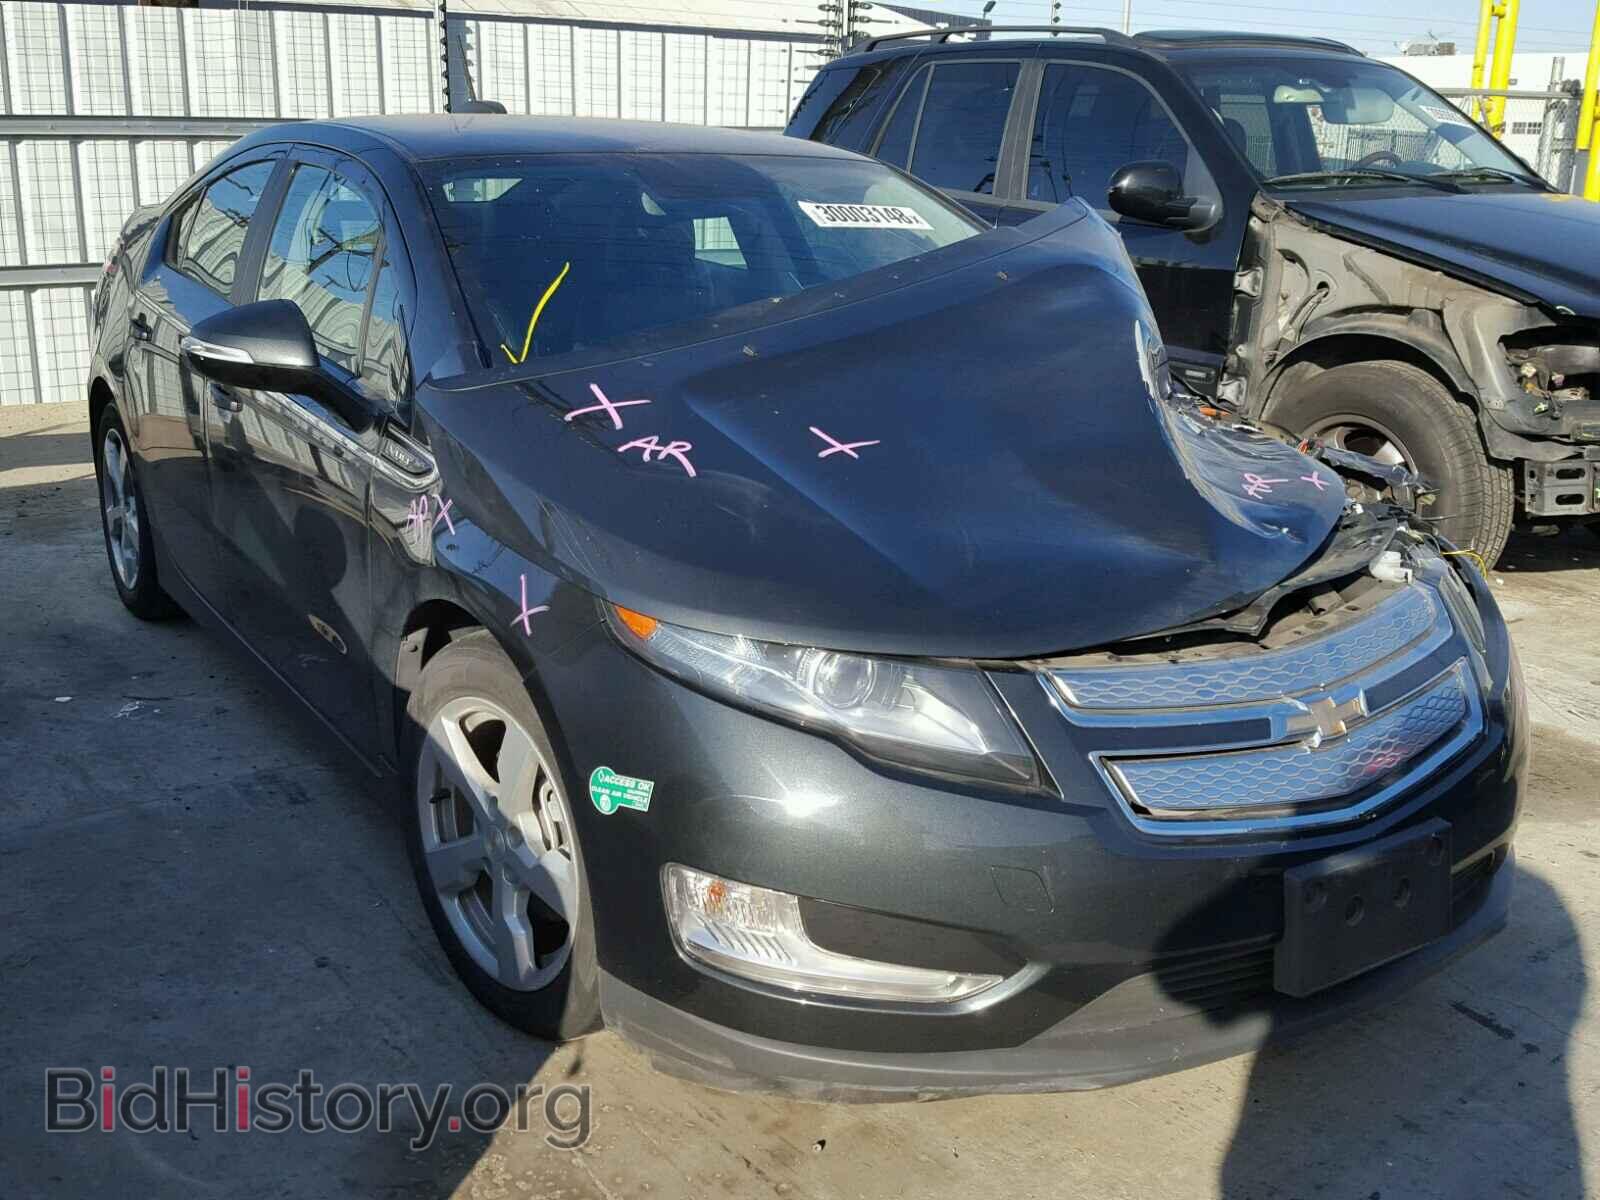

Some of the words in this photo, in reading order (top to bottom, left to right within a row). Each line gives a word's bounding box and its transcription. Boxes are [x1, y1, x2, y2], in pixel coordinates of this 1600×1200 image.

[617, 435, 697, 478] AR
[604, 775, 636, 788] ACCESS
[638, 782, 650, 791] OK
